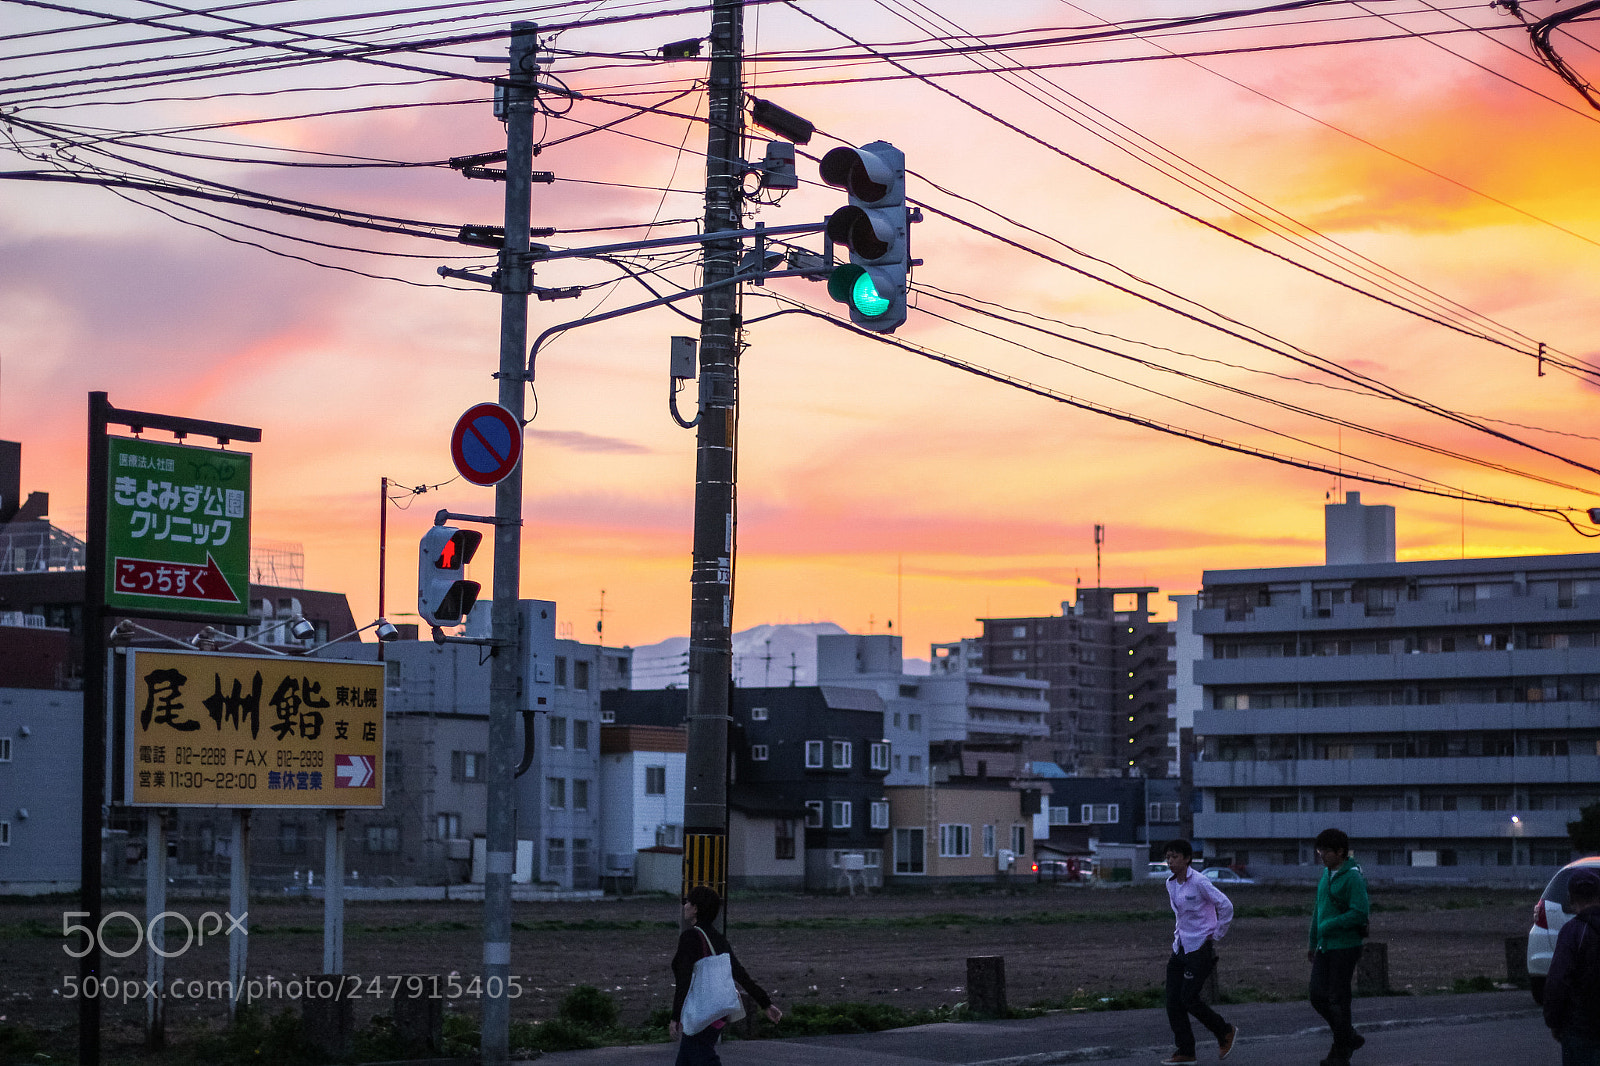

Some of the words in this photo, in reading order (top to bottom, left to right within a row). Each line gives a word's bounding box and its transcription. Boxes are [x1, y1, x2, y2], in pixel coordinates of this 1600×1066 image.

[119, 453, 175, 472] 医療法人社団
[114, 476, 245, 518] きよみず公園
[130, 511, 231, 546] クリニック
[120, 564, 208, 595] こっちすぐ
[140, 668, 331, 741] 尾州鮨
[335, 686, 377, 709] 東札幌
[139, 745, 166, 764] 電話
[234, 749, 268, 767] FAX
[139, 770, 166, 788] 営業
[268, 770, 323, 790] 無休営業
